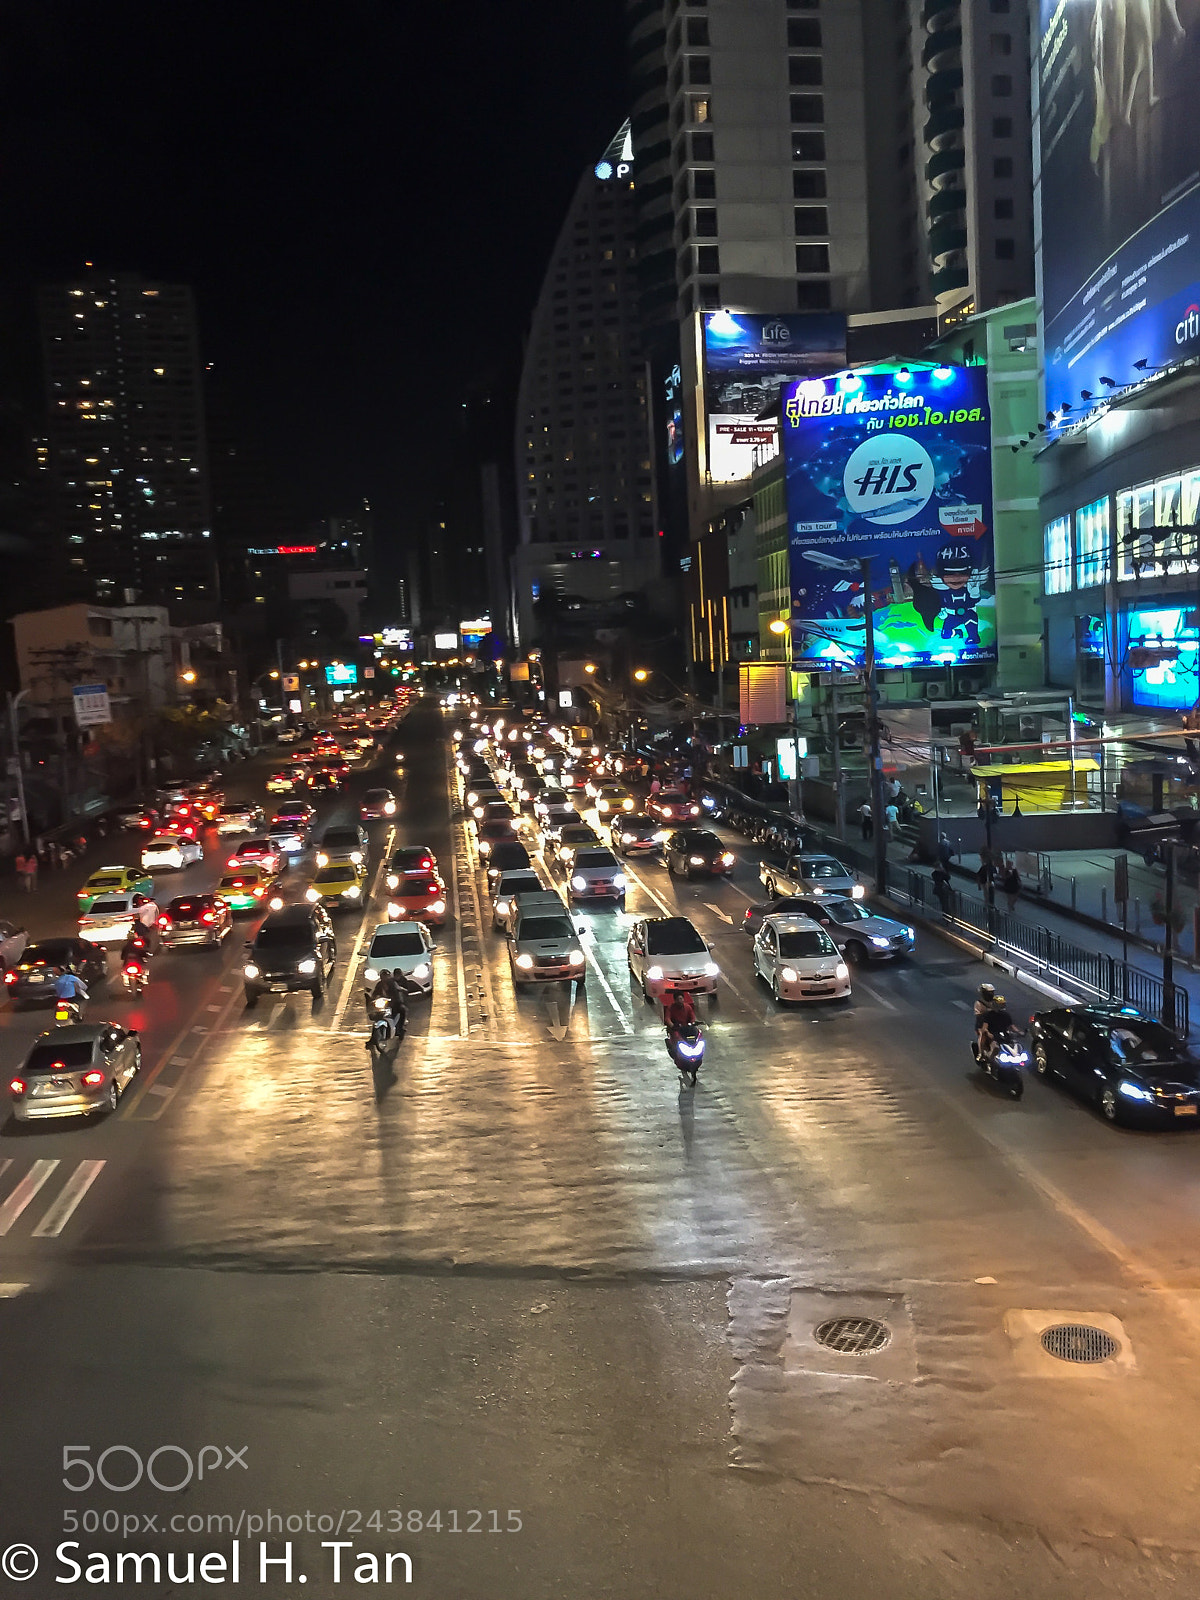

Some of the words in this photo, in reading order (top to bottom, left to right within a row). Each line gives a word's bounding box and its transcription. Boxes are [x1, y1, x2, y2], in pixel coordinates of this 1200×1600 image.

[762, 324, 790, 340] Life
[1175, 312, 1199, 344] citi
[866, 417, 885, 430] กับ
[888, 407, 986, 428] เอช.ไอ.เอส.
